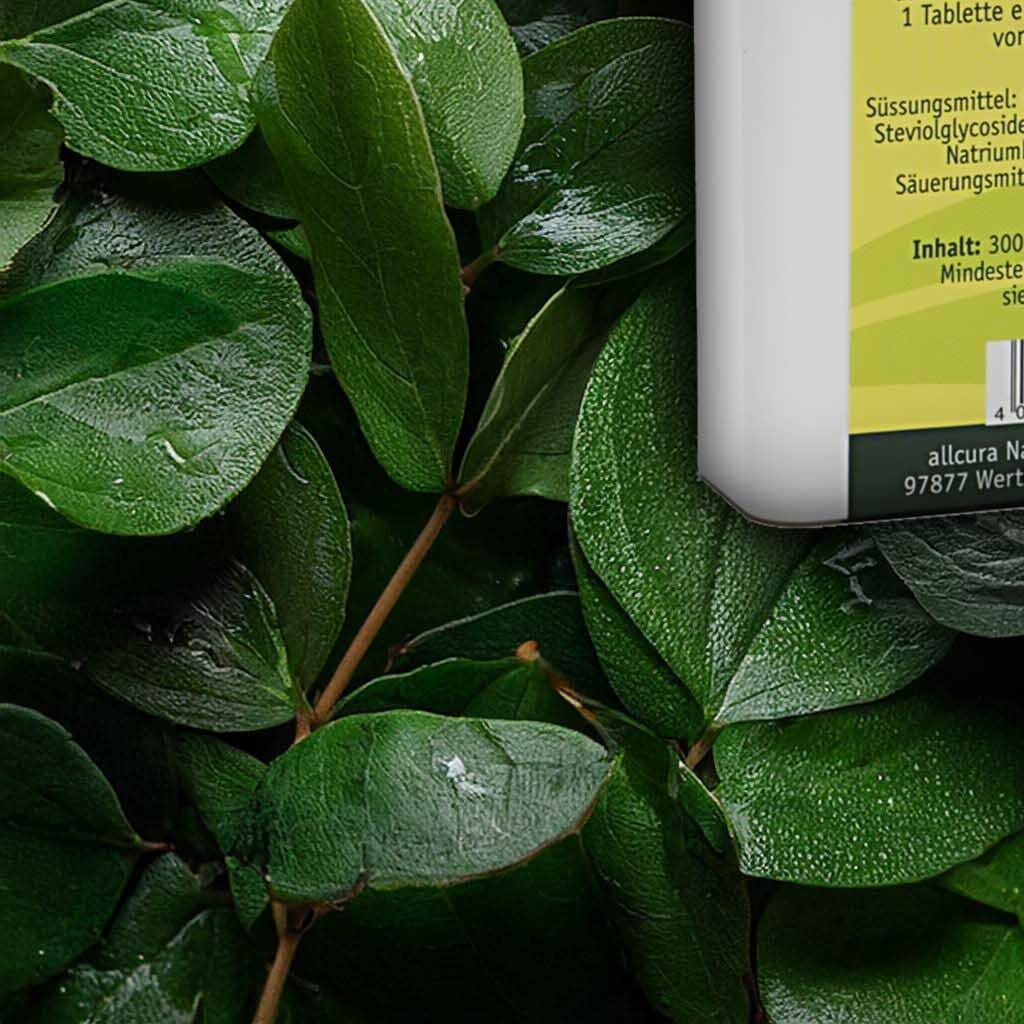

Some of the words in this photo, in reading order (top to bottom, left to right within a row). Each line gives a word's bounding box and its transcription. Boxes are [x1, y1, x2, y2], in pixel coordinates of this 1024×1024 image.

[902, 8, 911, 27] 1
[921, 0, 1003, 25] Tablette
[866, 88, 1017, 119] Süssungsmittel:
[912, 234, 981, 259] Inhalt:
[988, 232, 1024, 255] 300
[994, 407, 1004, 421] 4
[928, 443, 998, 466] allcura
[904, 471, 968, 496] 97877
